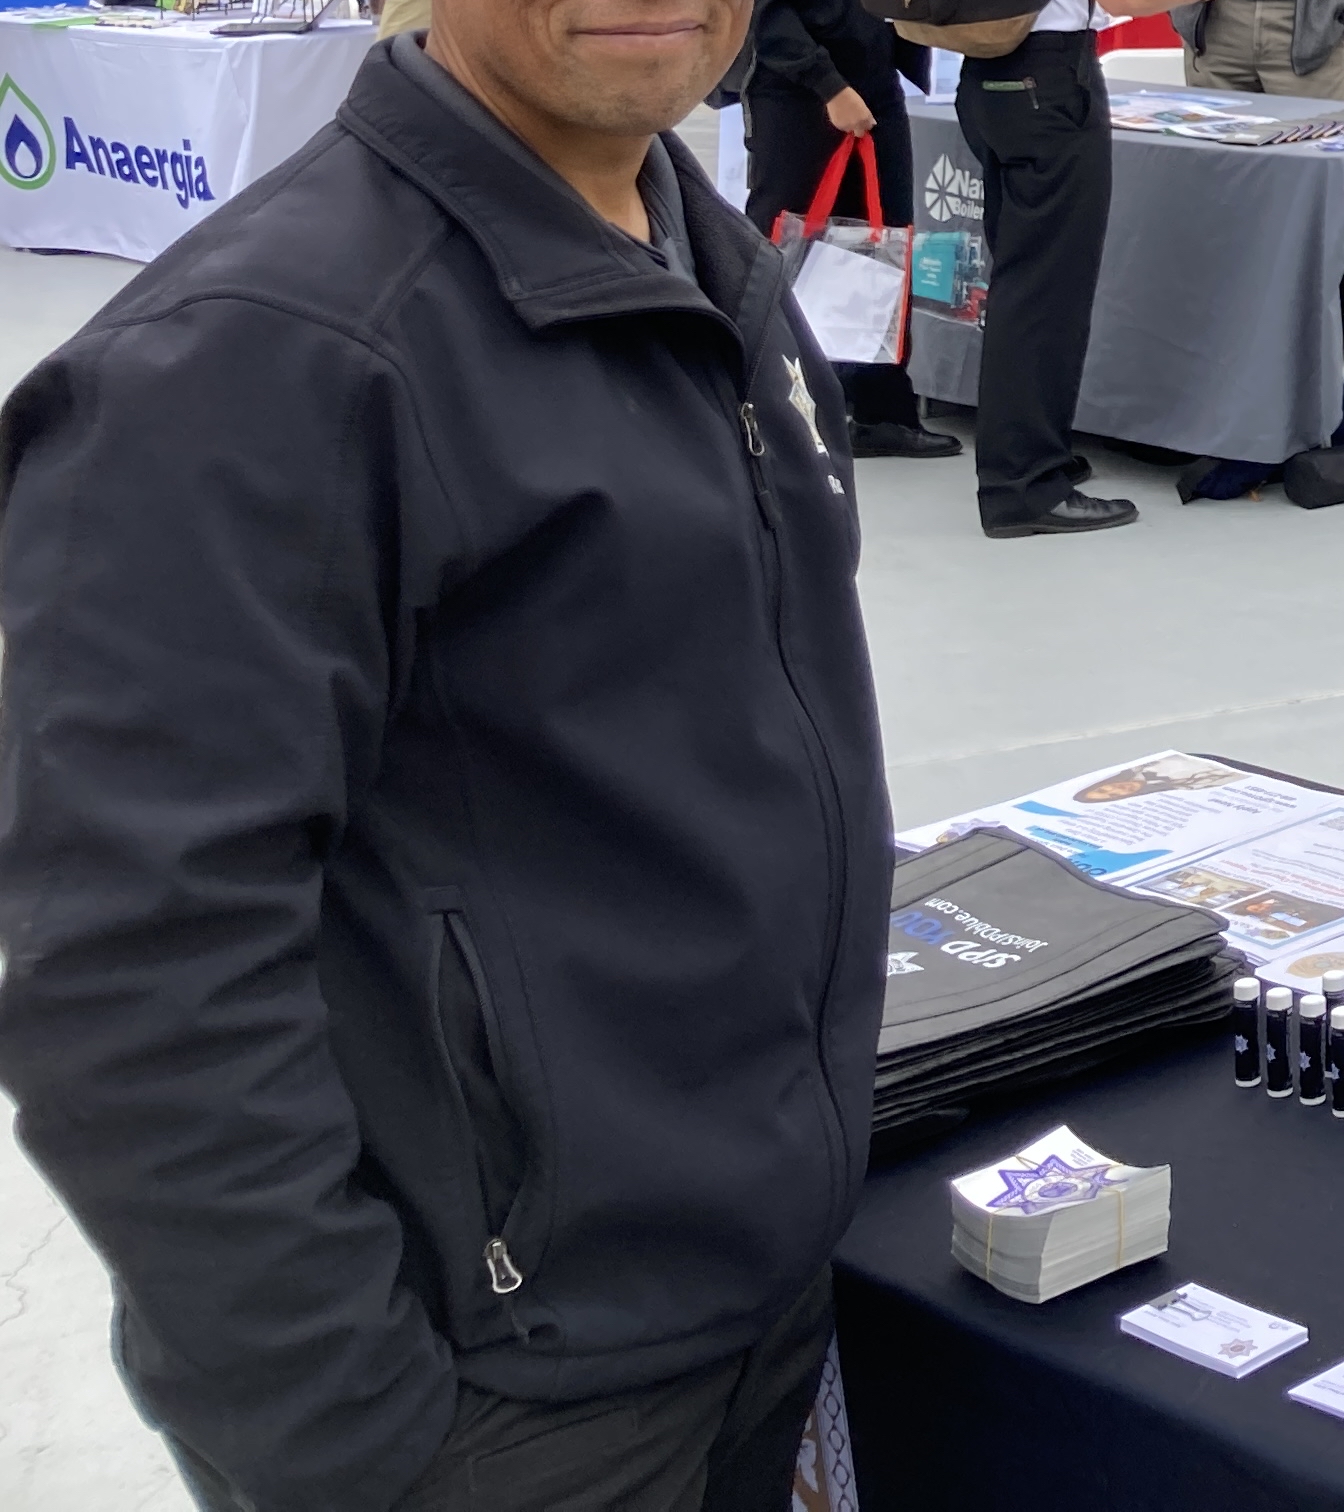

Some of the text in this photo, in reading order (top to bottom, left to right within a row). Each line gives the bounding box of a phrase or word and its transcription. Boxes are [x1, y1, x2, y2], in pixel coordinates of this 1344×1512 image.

[64, 116, 216, 210] Anaergia
[953, 198, 985, 221] Boiler
[891, 911, 1021, 968] SJPD YOU
[924, 897, 1048, 953] JoinSJPDblue.com
